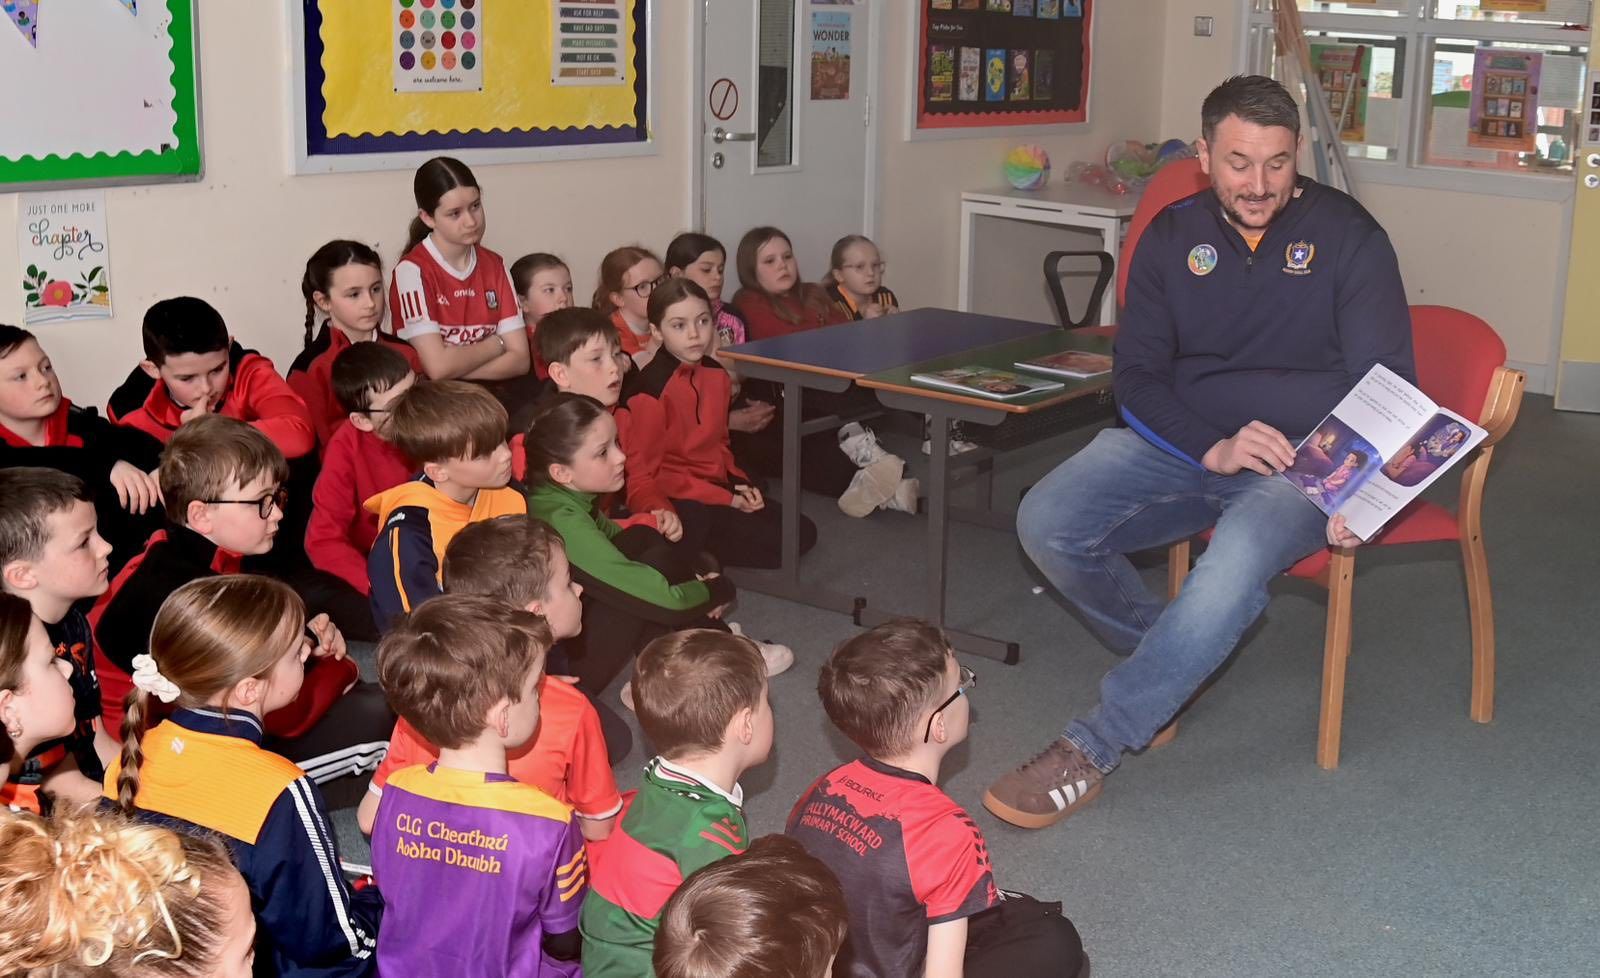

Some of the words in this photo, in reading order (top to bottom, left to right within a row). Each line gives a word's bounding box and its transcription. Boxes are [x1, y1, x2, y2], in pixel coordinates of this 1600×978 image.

[813, 30, 850, 41] WONDER
[28, 204, 47, 216] JUST
[50, 203, 68, 214] ONE
[72, 202, 96, 213] MORE
[29, 218, 104, 260] chapter
[396, 813, 423, 835] CLG
[800, 814, 838, 835] PRIMARY
[836, 827, 868, 857] SCHOOL
